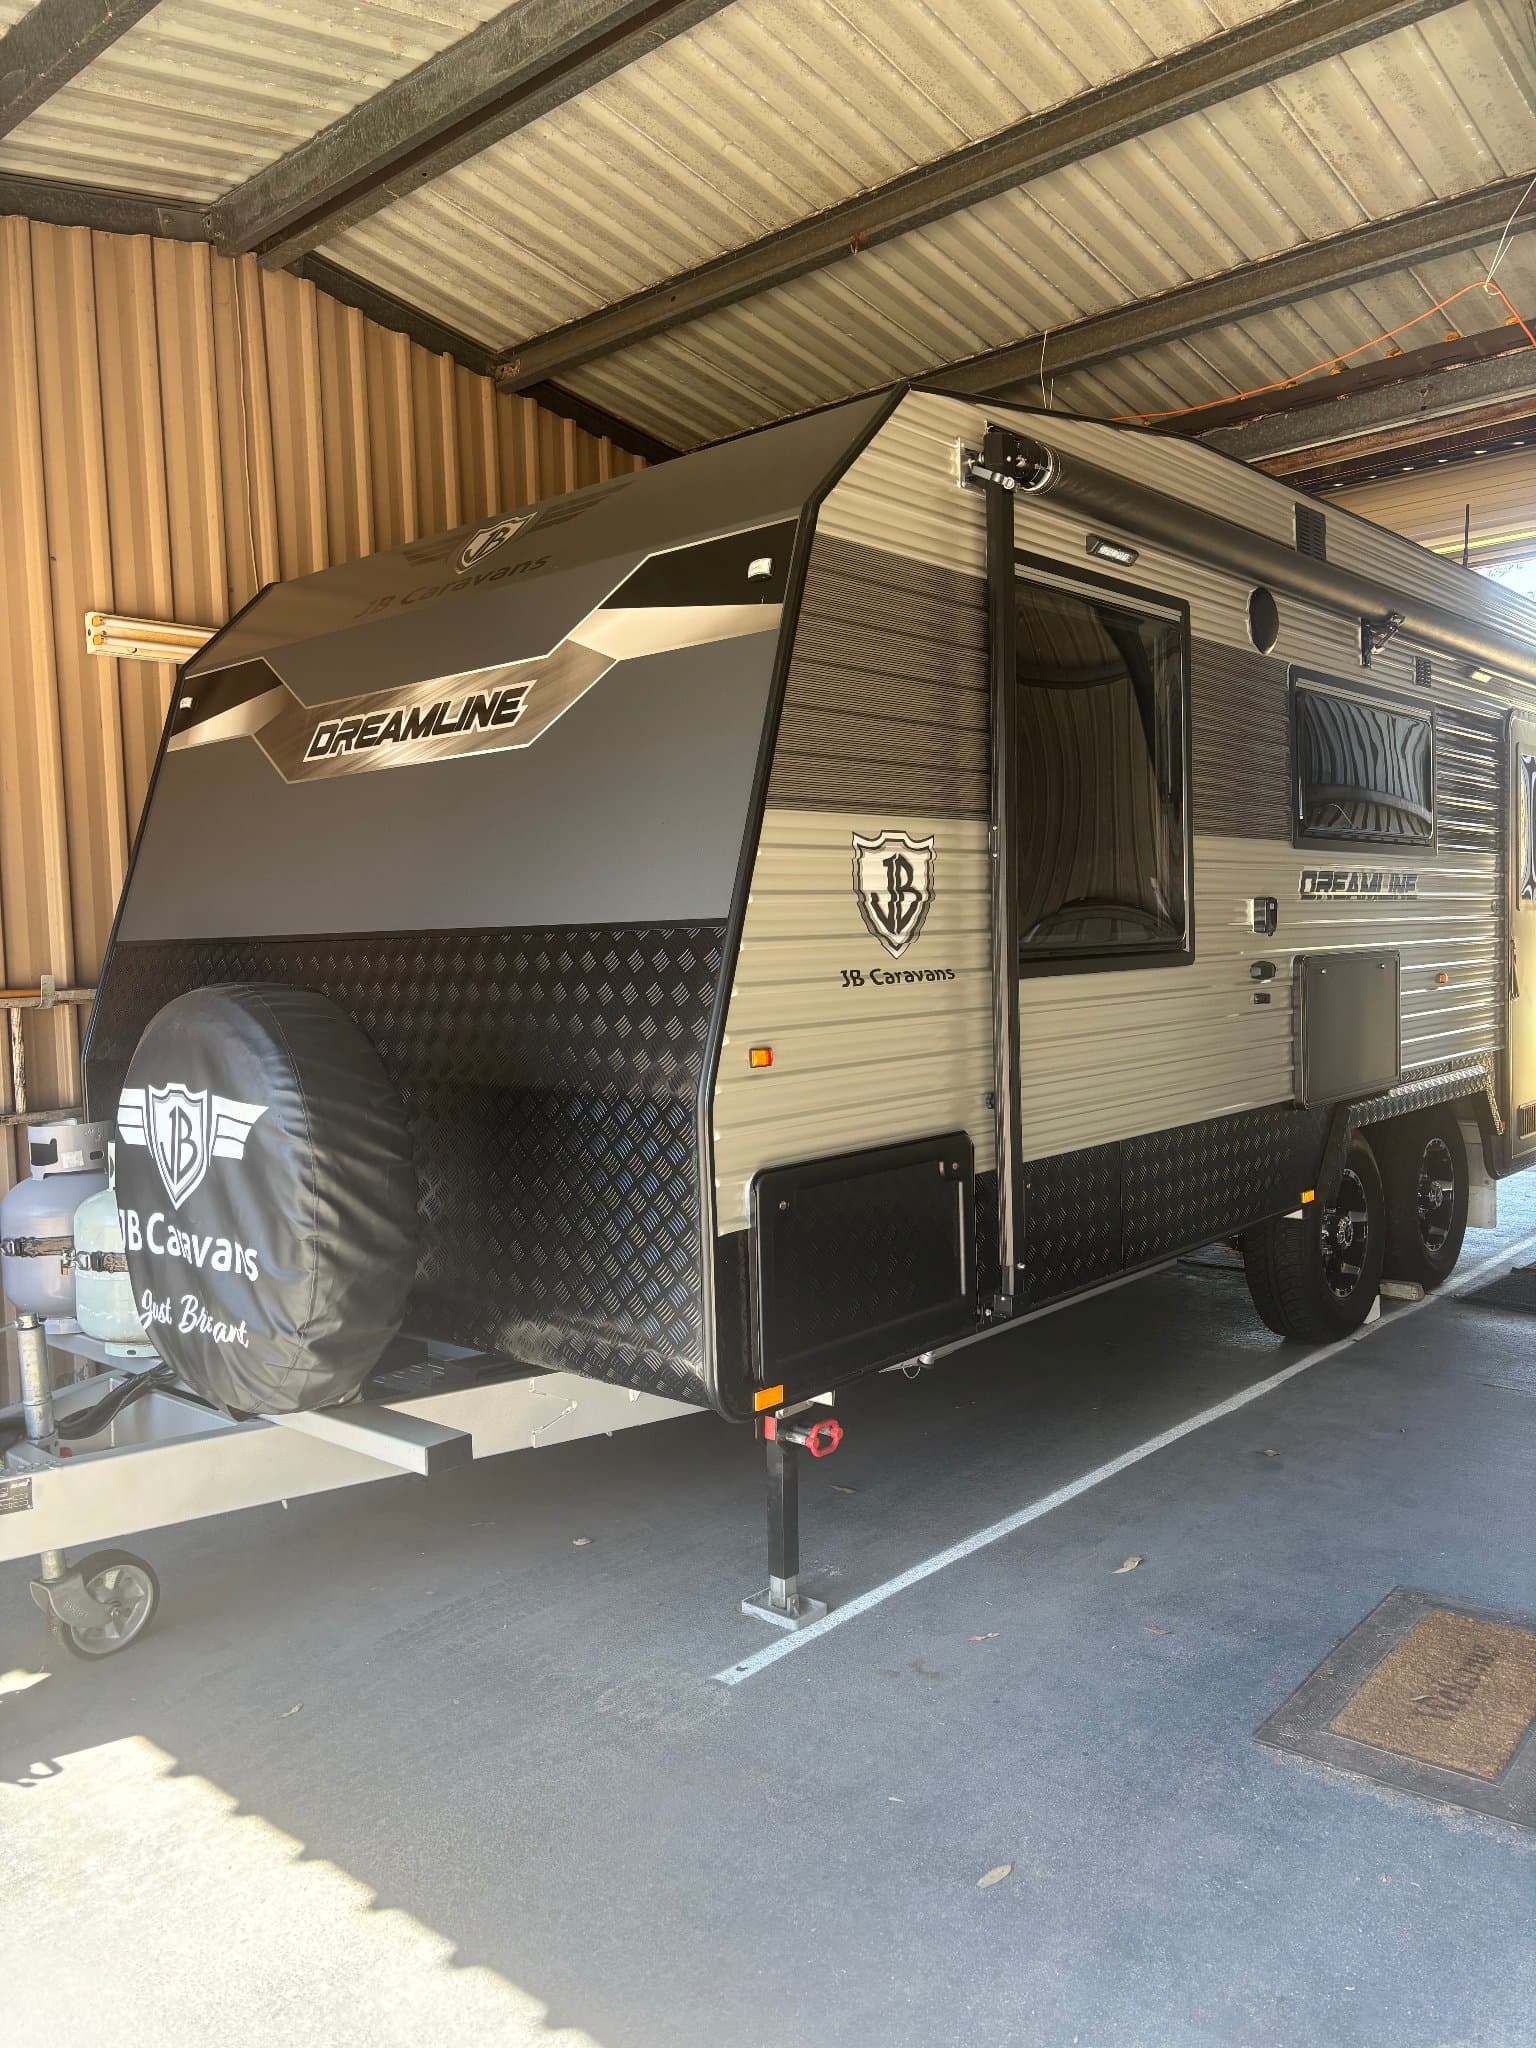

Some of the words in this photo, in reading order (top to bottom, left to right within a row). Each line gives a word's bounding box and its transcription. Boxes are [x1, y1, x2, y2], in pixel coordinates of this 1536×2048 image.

[400, 554, 553, 606] Caravans
[303, 680, 537, 762] DREAMLINE
[1298, 869, 1420, 901] DREAMLINE
[840, 968, 866, 988] JB
[868, 967, 956, 987] Caravans
[118, 1208, 143, 1252] JB
